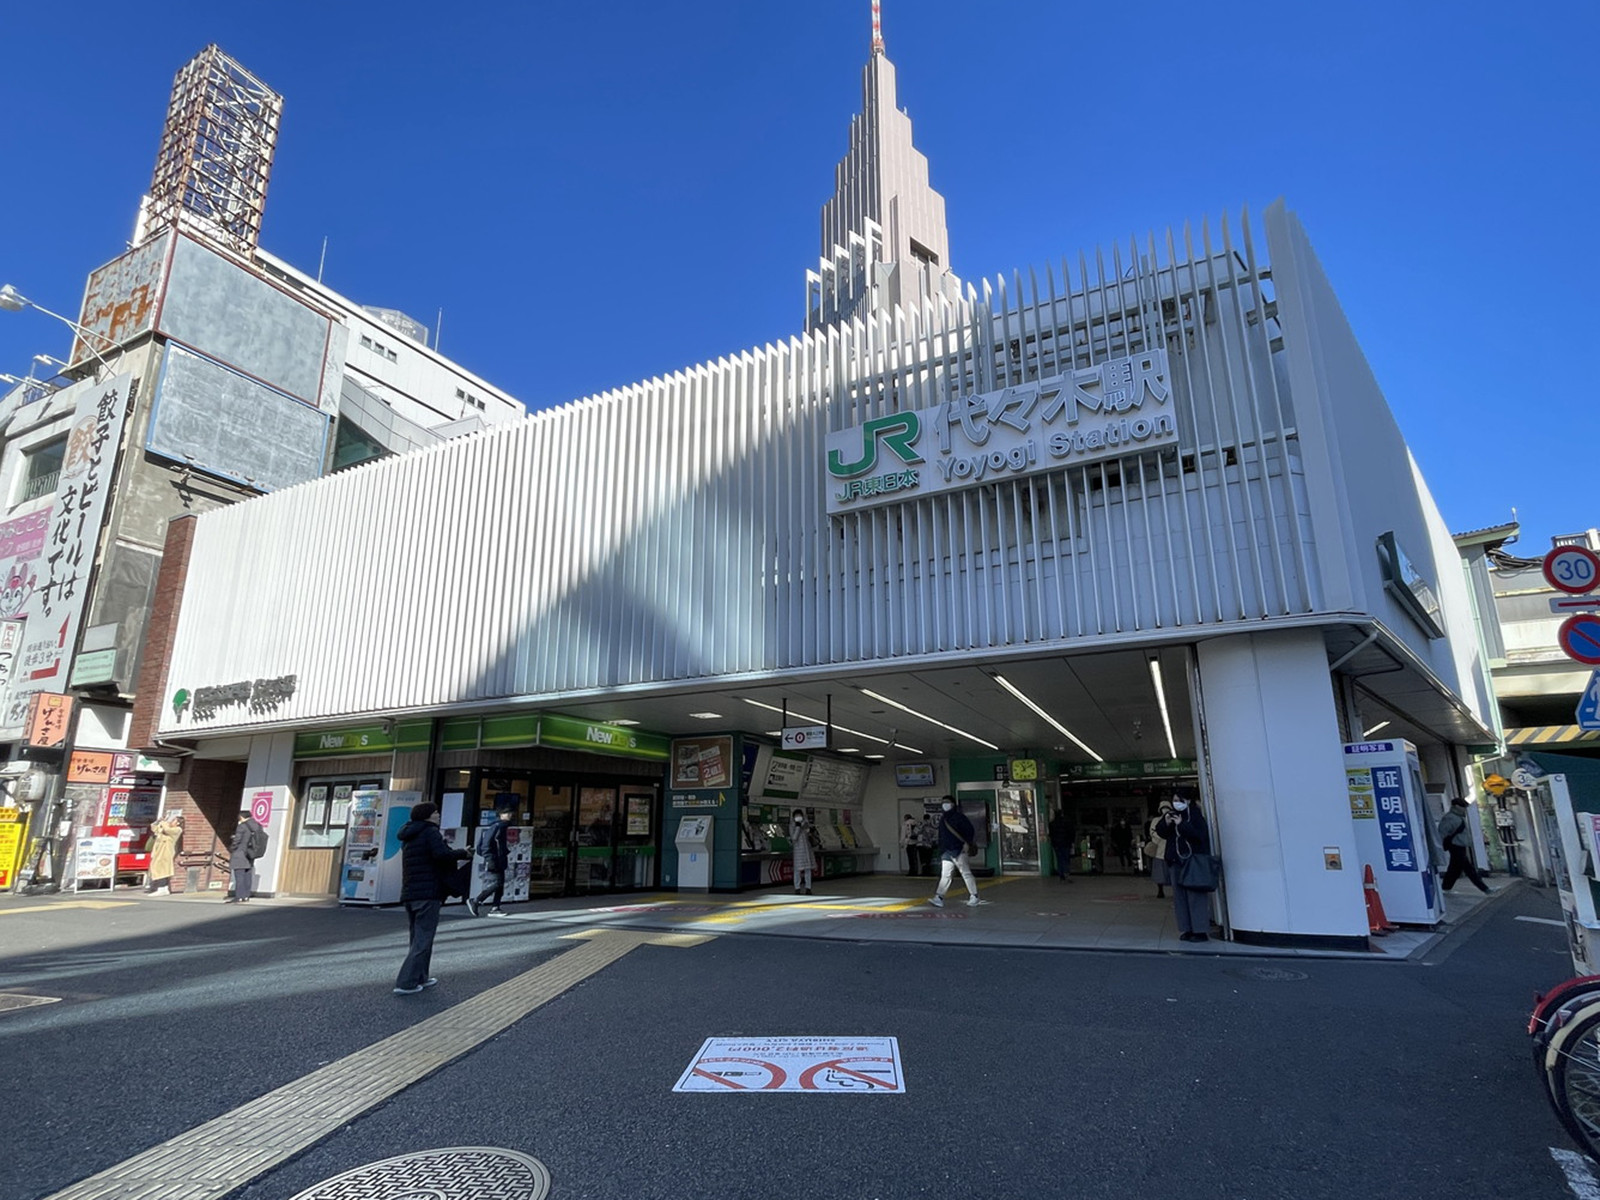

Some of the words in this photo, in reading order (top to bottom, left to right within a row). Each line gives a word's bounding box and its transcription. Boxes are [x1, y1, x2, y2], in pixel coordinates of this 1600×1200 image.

[935, 349, 1168, 452] 代々木駅
[827, 410, 922, 478] JR
[937, 439, 1037, 482] Yoyogi
[1050, 413, 1173, 458] Station
[835, 468, 919, 502] JR東日本
[1557, 559, 1591, 580] 30
[1351, 743, 1386, 753] 証明写真
[1376, 770, 1413, 867] 証明写真
